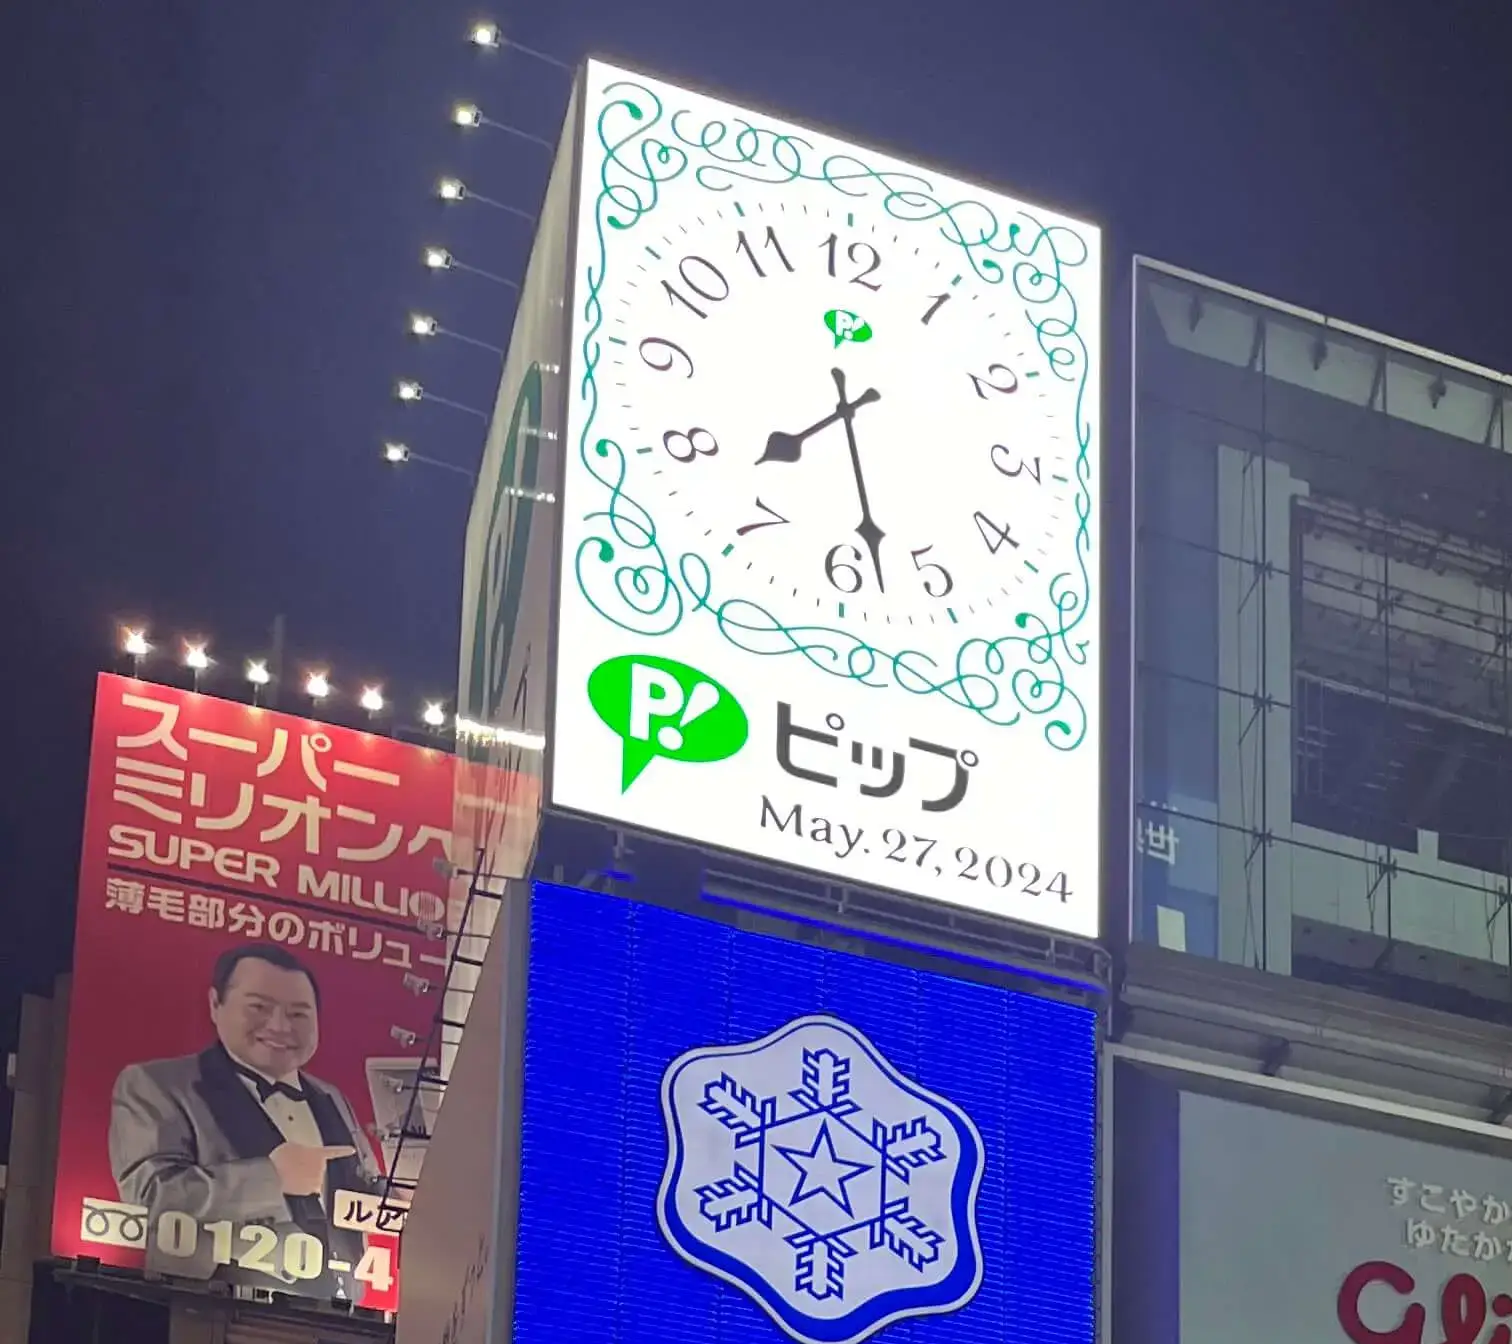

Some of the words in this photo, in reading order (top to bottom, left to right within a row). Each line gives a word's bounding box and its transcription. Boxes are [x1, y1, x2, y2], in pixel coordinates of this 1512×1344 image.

[734, 225, 800, 279] 11
[818, 231, 884, 294] 12
[659, 254, 730, 321] 10
[920, 291, 953, 326] 1
[638, 336, 697, 380] 9
[967, 362, 1019, 400] 2
[662, 426, 719, 467] 8
[989, 444, 1042, 486] 3
[737, 497, 791, 537] 7
[970, 510, 1019, 555] 4
[823, 544, 864, 594] 6
[910, 546, 955, 600] 5
[117, 692, 400, 791] スーパー
[774, 699, 980, 814] ピップ
[107, 826, 279, 889] SUPER
[758, 794, 871, 857] May.
[954, 845, 1075, 905] 2024
